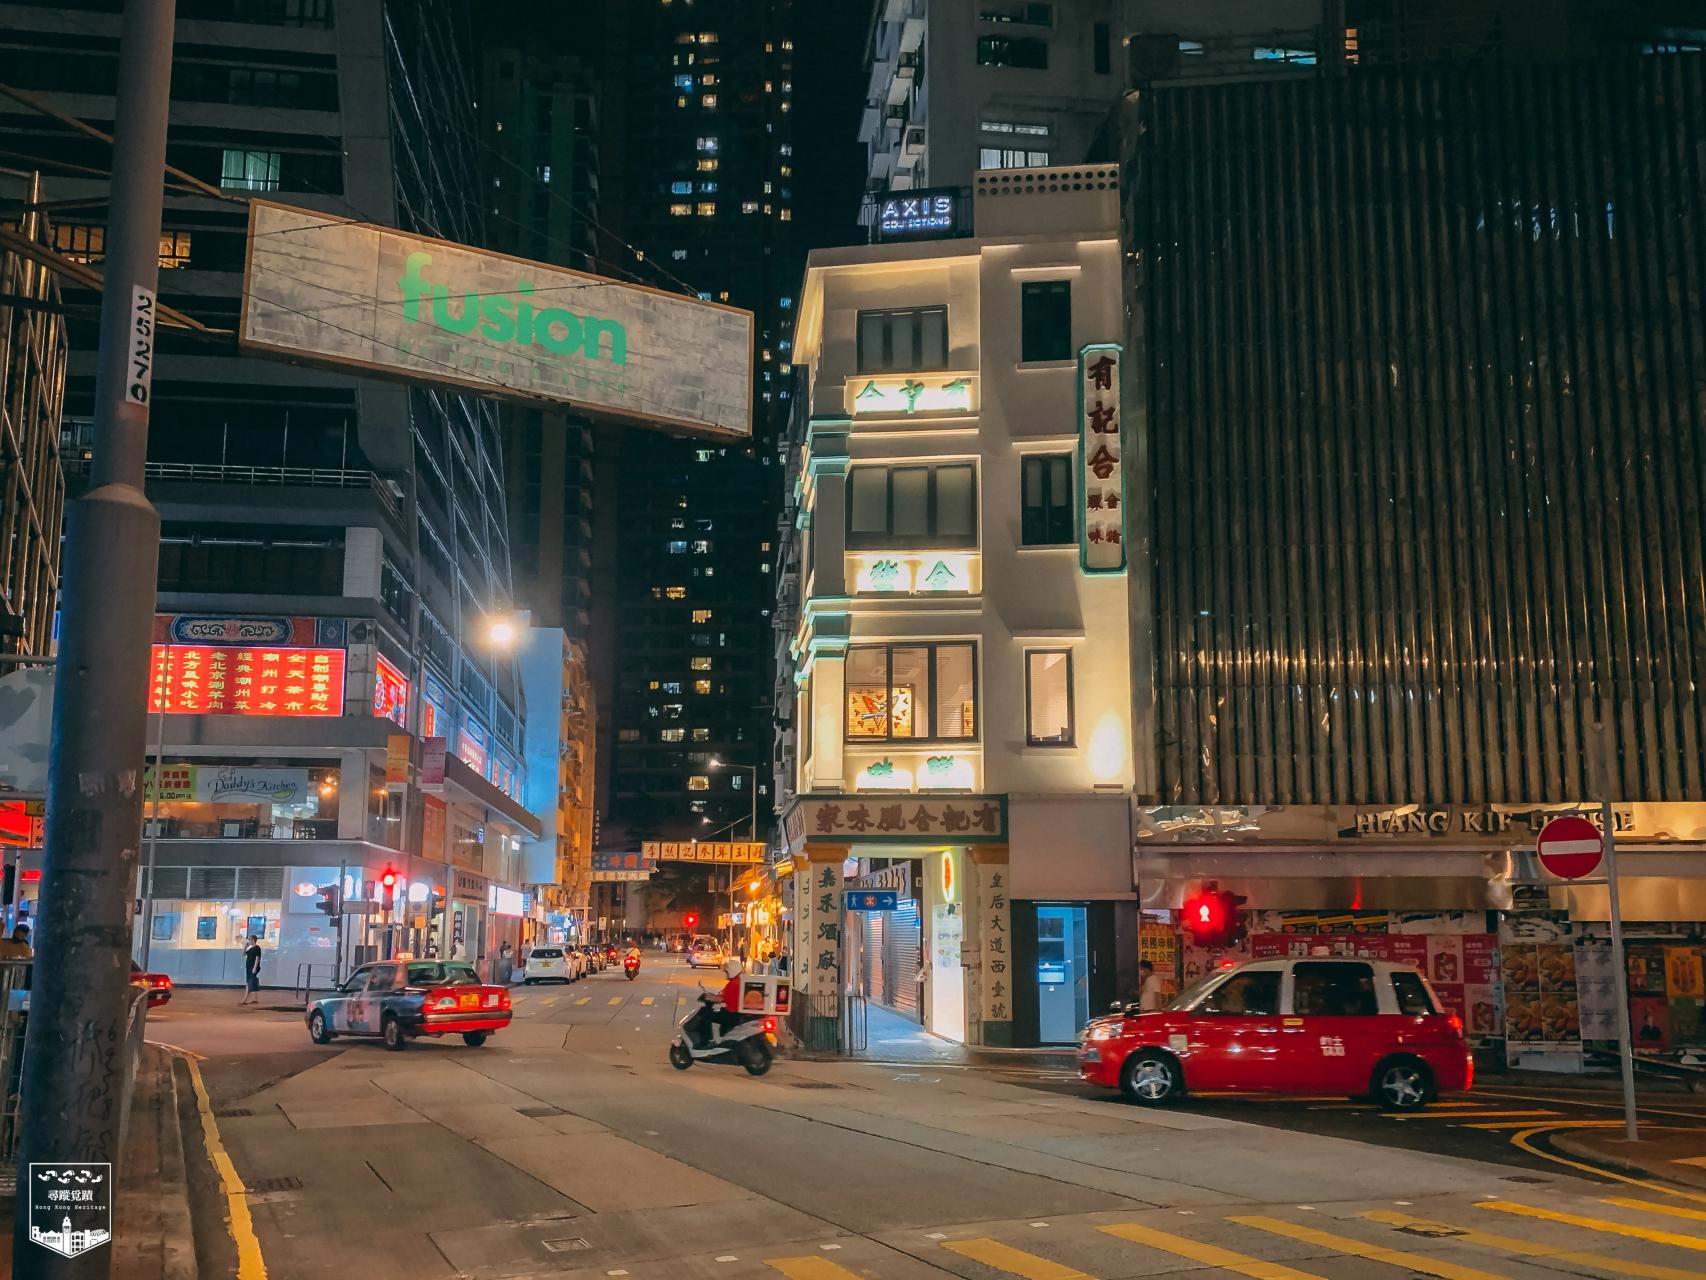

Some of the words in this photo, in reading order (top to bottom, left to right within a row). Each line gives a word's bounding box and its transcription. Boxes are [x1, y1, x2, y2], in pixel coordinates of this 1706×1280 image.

[883, 197, 951, 217] AXIS
[400, 252, 627, 366] fusion
[131, 295, 152, 402] 25270
[207, 776, 254, 793] Daddy's
[257, 781, 297, 792] Kitchen
[1356, 810, 1449, 832] HIANG
